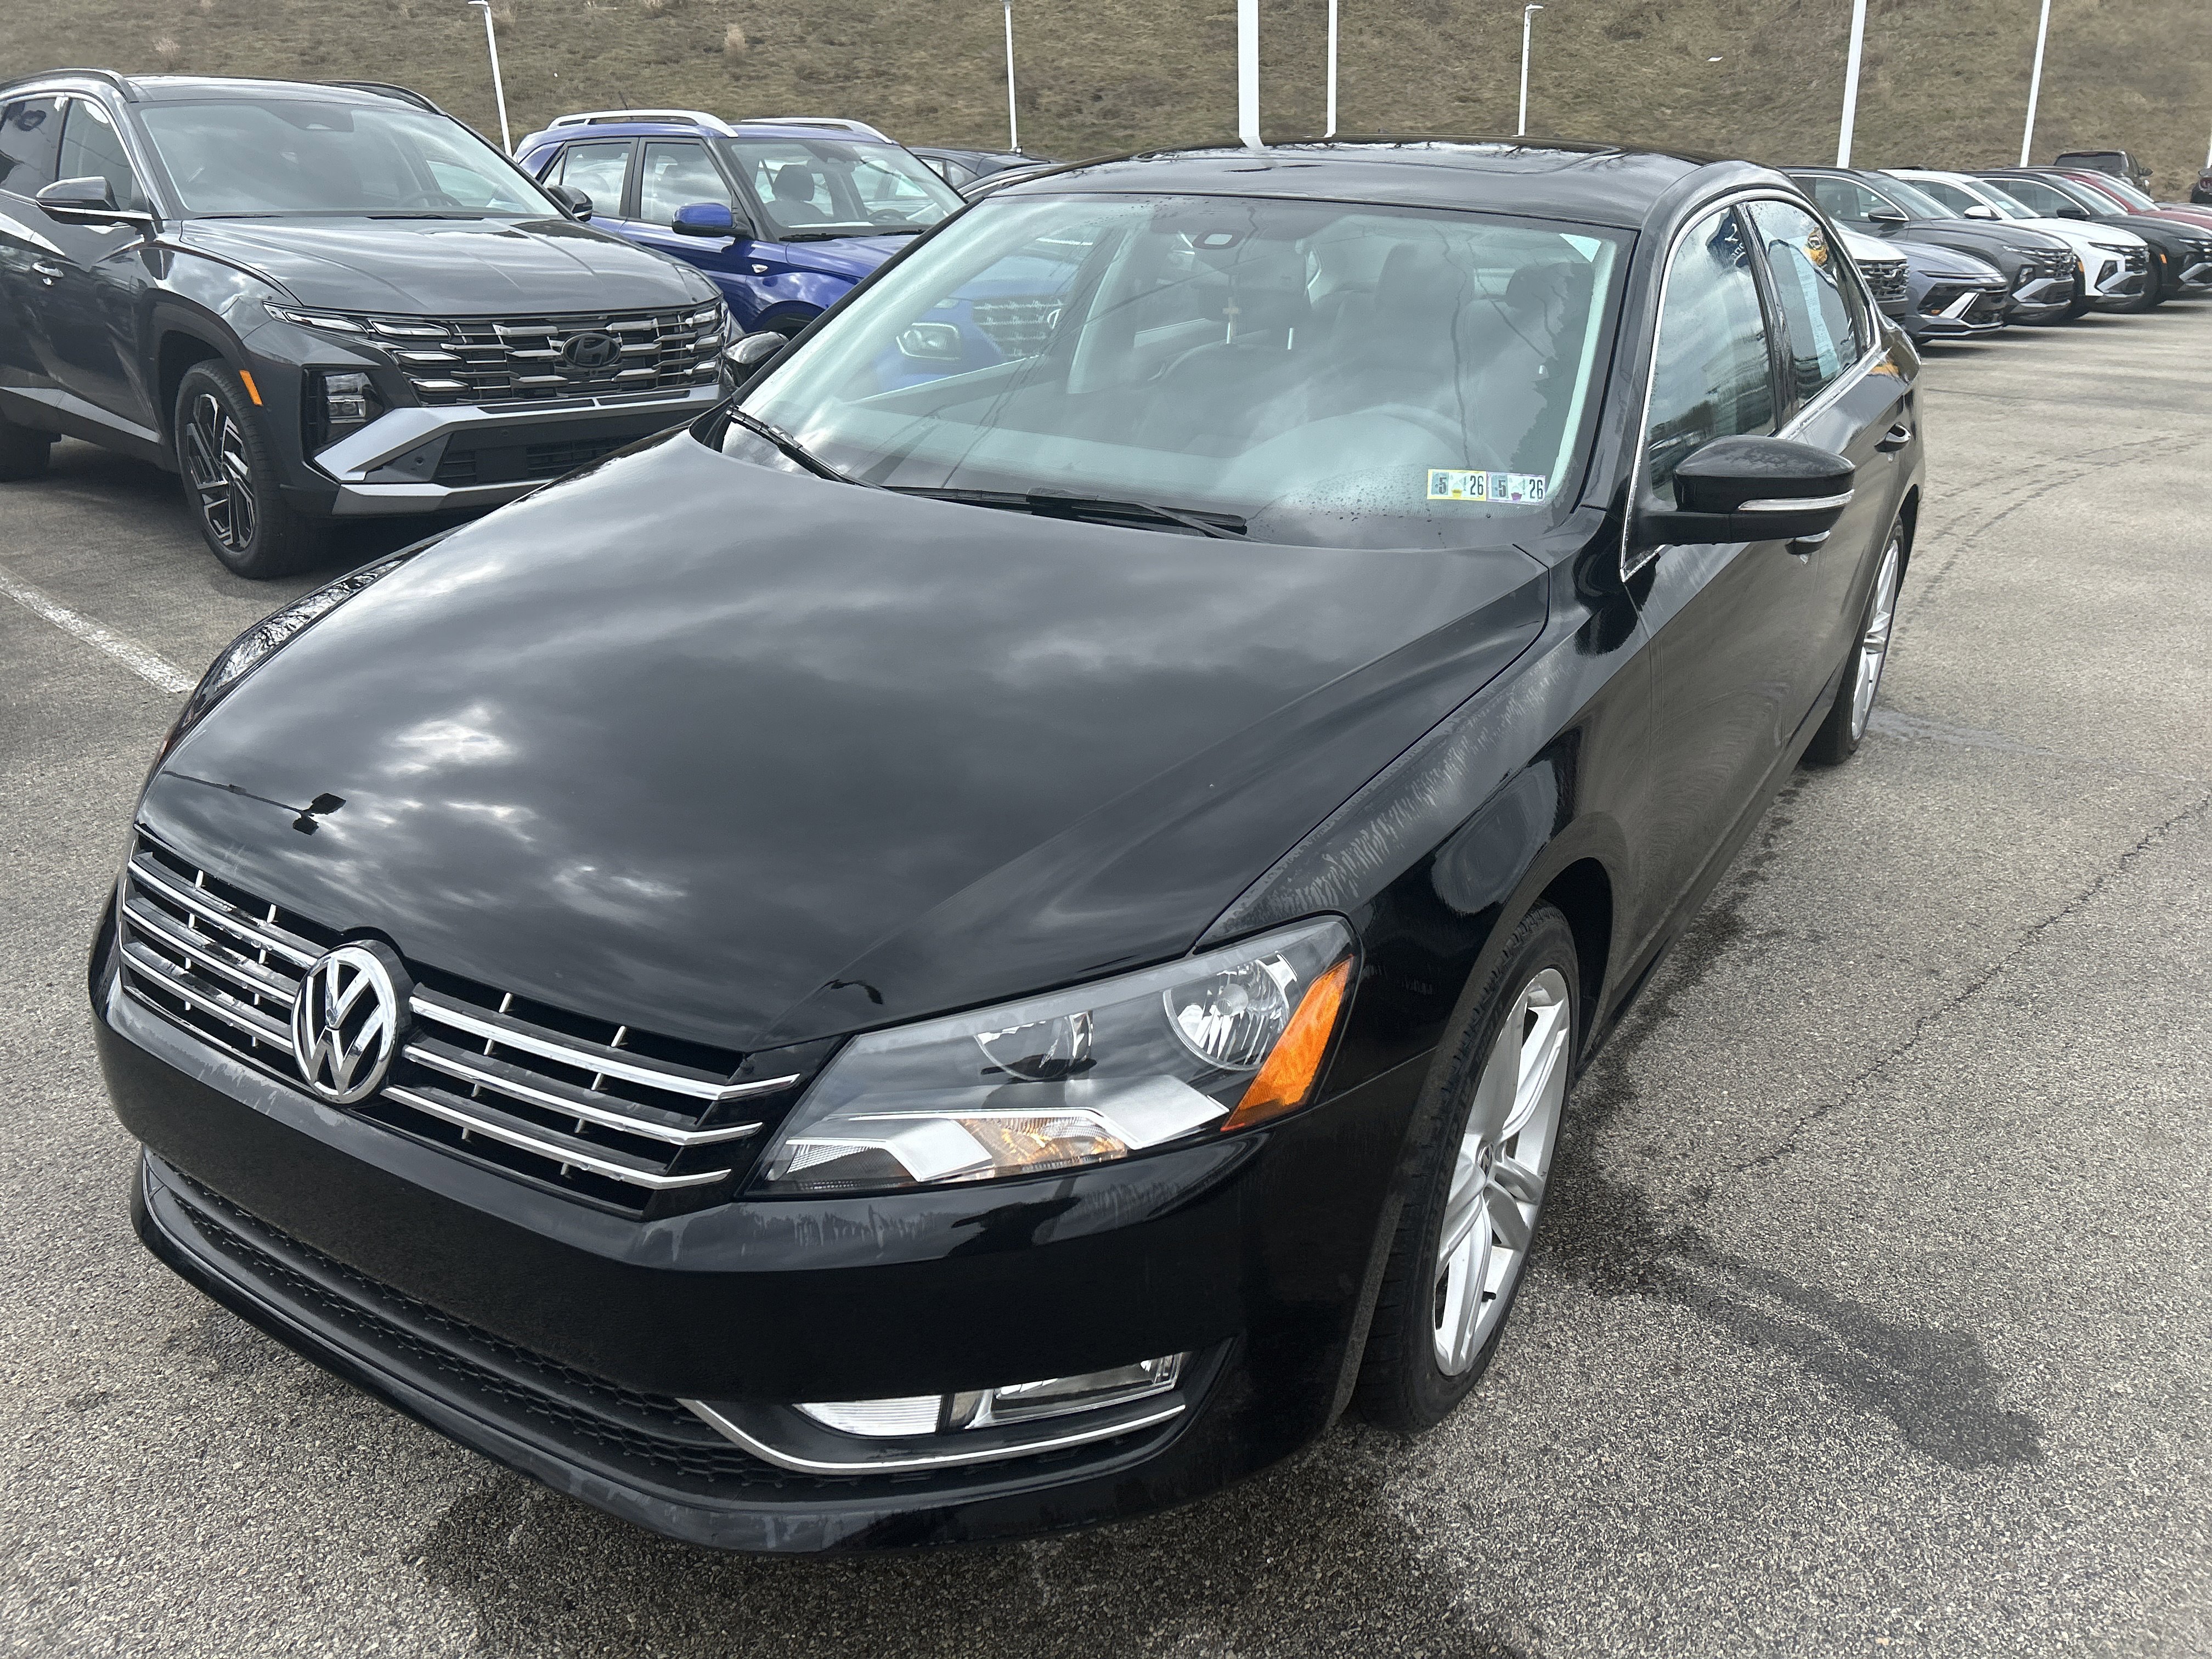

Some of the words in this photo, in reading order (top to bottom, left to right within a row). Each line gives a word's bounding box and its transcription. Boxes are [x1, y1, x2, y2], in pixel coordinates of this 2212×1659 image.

[1438, 477, 1447, 494] 5
[1470, 475, 1483, 495] 26
[1498, 479, 1506, 497] 5
[1530, 479, 1543, 499] 26
